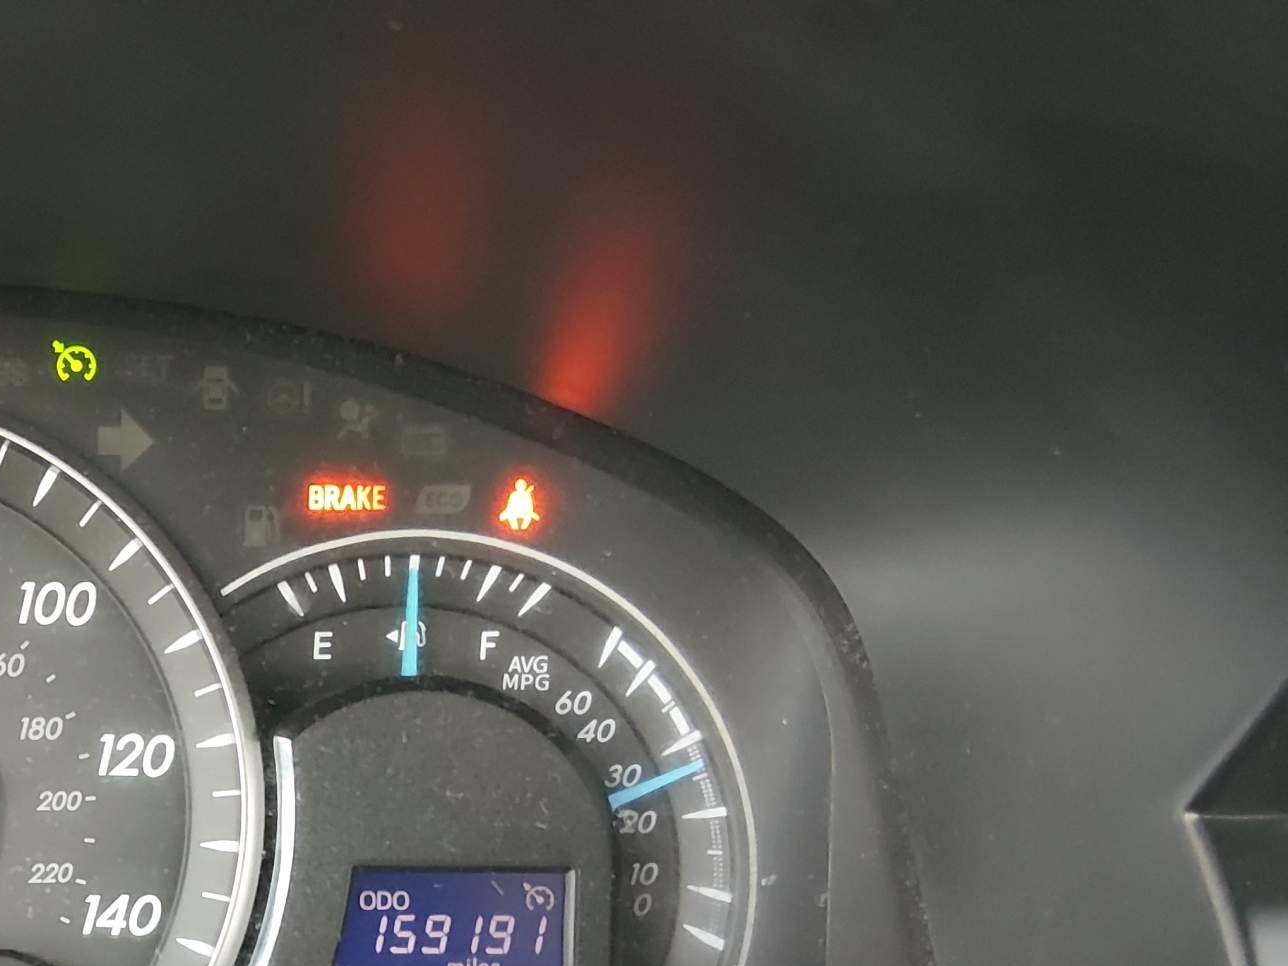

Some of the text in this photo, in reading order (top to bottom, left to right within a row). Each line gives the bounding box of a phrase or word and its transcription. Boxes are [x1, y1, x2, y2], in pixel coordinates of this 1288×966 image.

[308, 484, 386, 512] BRAKE
[18, 580, 97, 627] 100
[314, 632, 332, 661] E
[480, 631, 500, 660] F
[508, 655, 549, 675] AVG
[501, 673, 550, 691] MPG
[555, 691, 592, 716] 60
[19, 715, 63, 742] 180
[576, 719, 616, 743] 40
[97, 733, 176, 778] 120
[604, 765, 642, 789] 30
[37, 788, 83, 813] 200
[619, 811, 657, 834] 20
[28, 861, 74, 885] 220
[630, 863, 658, 886] 10
[359, 890, 410, 911] ODO
[633, 893, 652, 917] 0
[81, 893, 162, 937] 140
[375, 915, 548, 955] 159191
